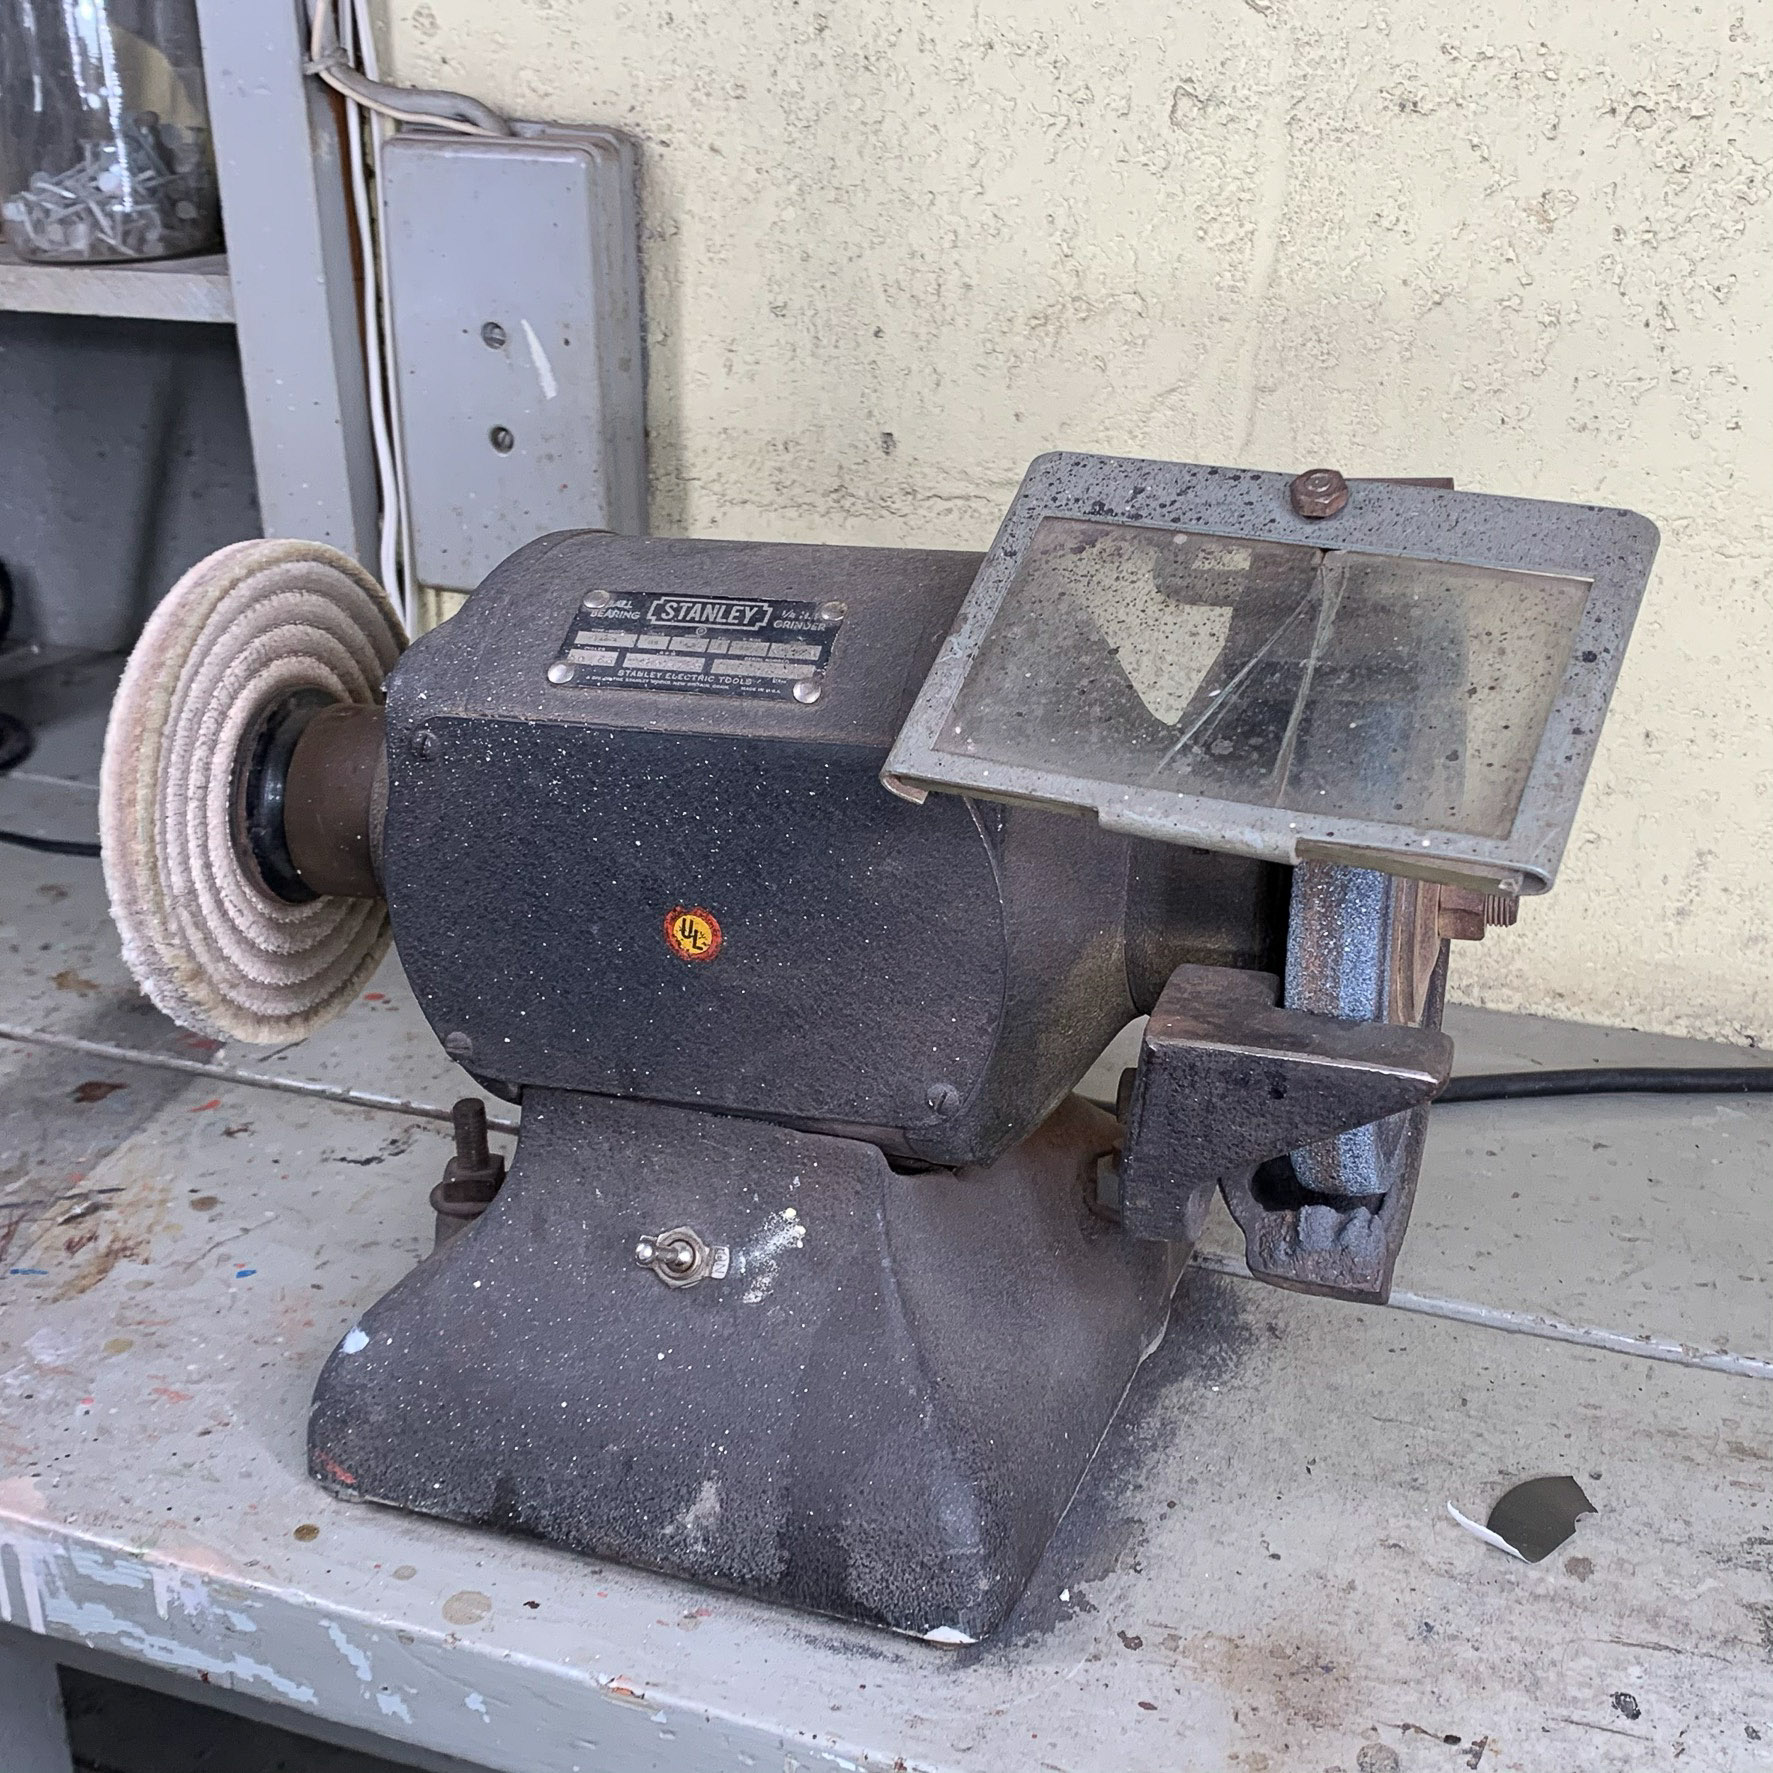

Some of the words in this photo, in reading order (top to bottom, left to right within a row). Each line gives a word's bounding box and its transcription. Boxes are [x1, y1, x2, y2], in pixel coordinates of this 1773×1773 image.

[590, 609, 640, 619] BEARING
[661, 602, 758, 624] STANLEY
[773, 620, 826, 631] GRINDER
[617, 669, 662, 679] STANLEY
[665, 672, 715, 683] ELECTRIC
[719, 677, 753, 685] TOOLS
[681, 917, 703, 951] UL
[714, 1251, 728, 1274] ON
